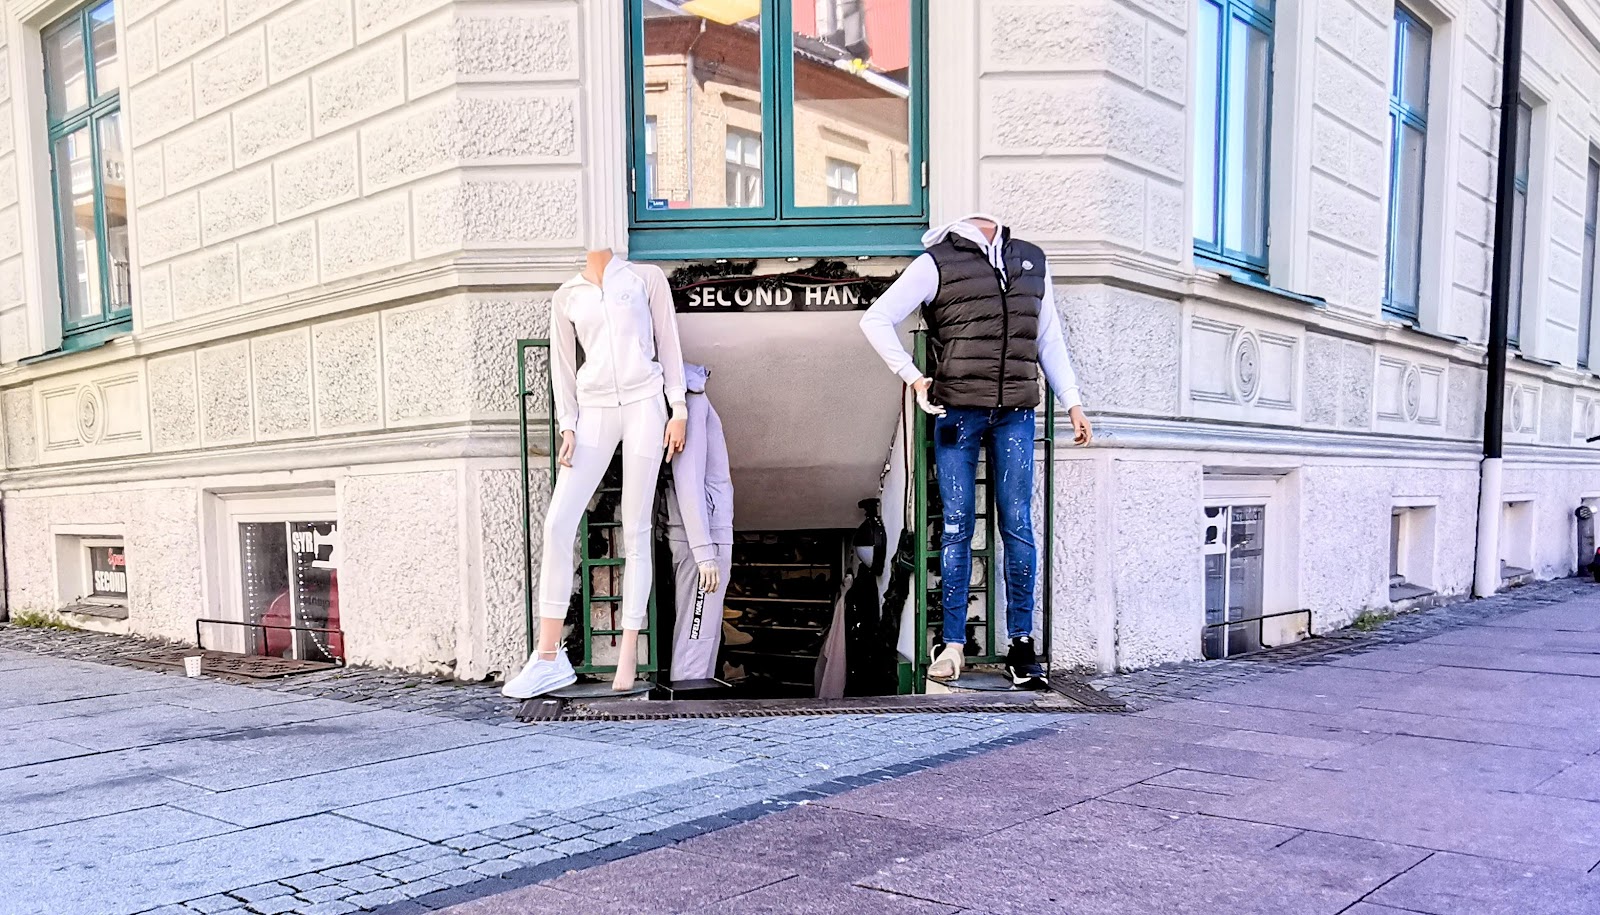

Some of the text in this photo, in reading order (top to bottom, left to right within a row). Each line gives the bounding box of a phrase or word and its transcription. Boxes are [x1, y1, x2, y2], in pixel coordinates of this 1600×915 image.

[688, 285, 875, 306] SECOND HAN
[94, 570, 126, 592] SECOND
[695, 599, 703, 616] KARL
